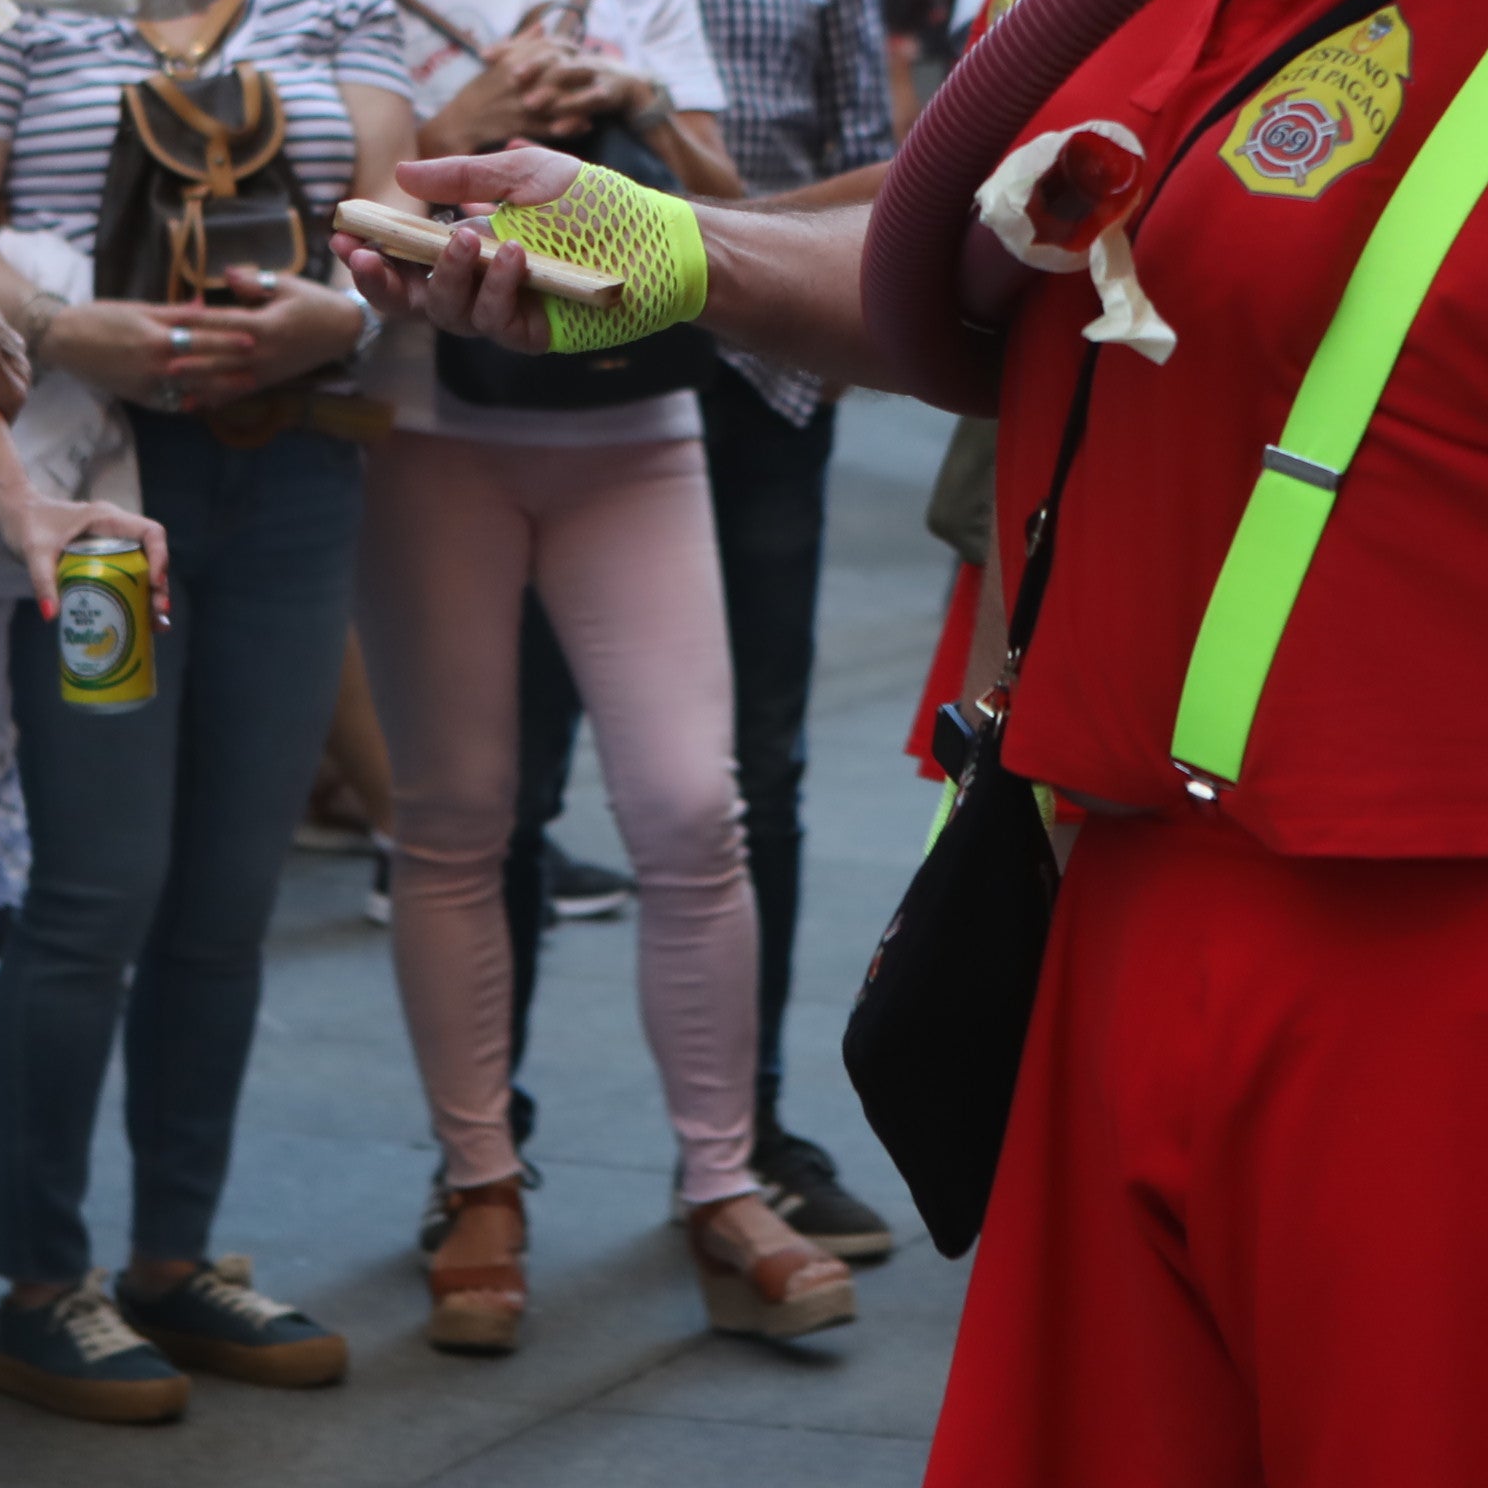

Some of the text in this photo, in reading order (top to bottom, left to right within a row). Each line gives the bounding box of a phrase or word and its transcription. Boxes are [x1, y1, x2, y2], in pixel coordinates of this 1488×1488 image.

[1359, 57, 1389, 89] NO
[1321, 68, 1387, 135] PAGAO
[1265, 121, 1312, 156] 69
